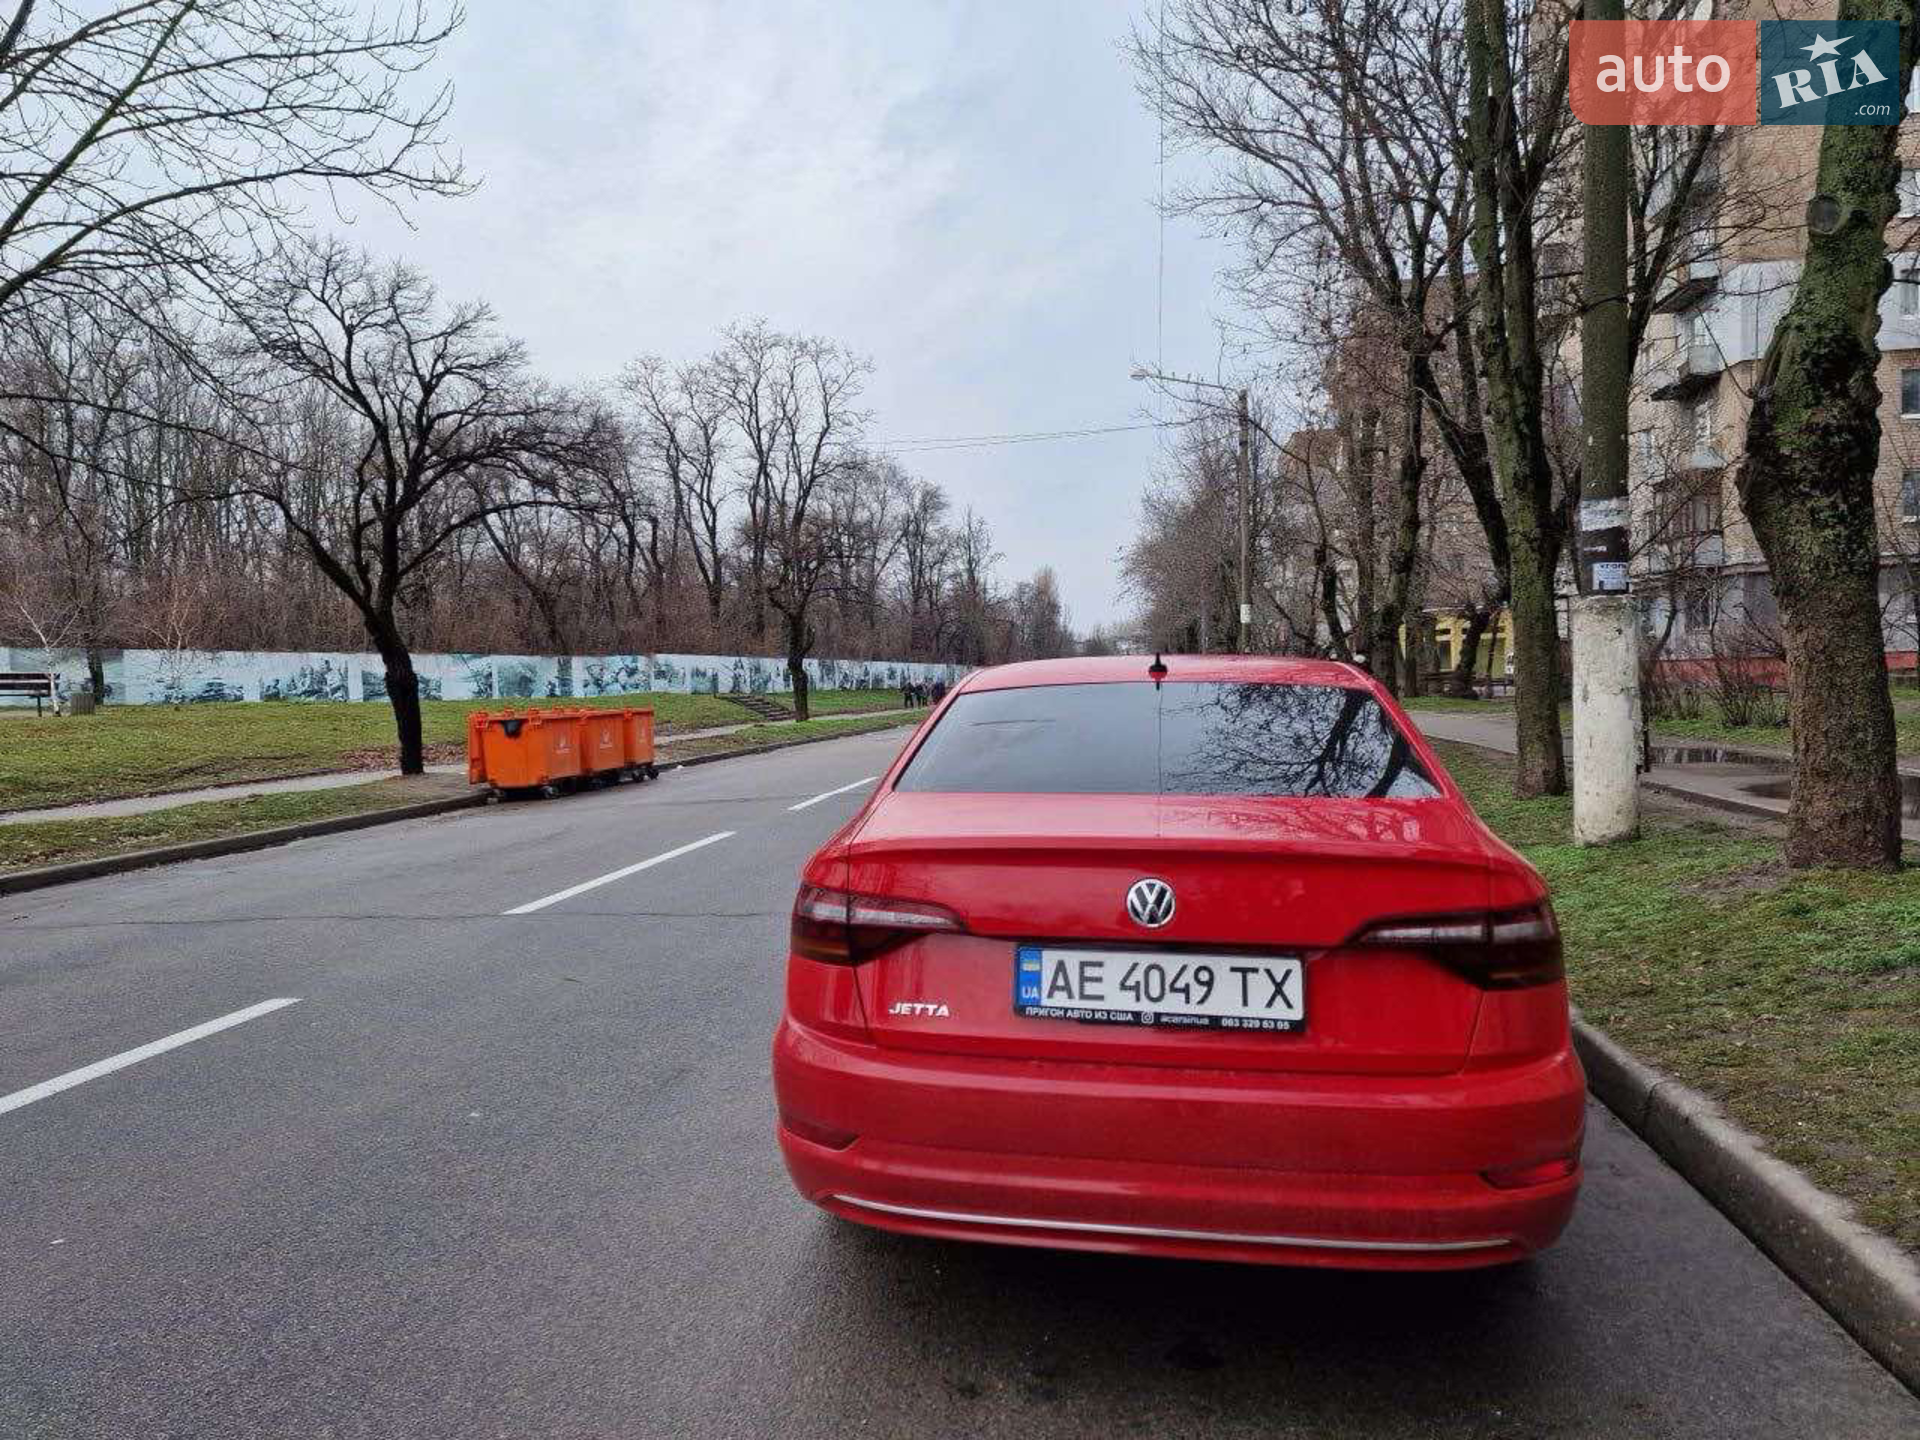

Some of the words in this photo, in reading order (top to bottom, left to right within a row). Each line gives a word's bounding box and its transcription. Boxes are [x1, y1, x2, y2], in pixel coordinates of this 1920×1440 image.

[1047, 959, 1105, 1001] AE
[1119, 962, 1215, 1006] 4049
[1230, 966, 1294, 1010] TX
[1022, 986, 1040, 999] UA
[888, 1002, 950, 1017] JETTA
[1025, 1006, 1065, 1018] ПРИГОН
[1066, 1009, 1093, 1019] АВТО
[1094, 1010, 1108, 1020] ИЗ
[1109, 1011, 1134, 1021] США
